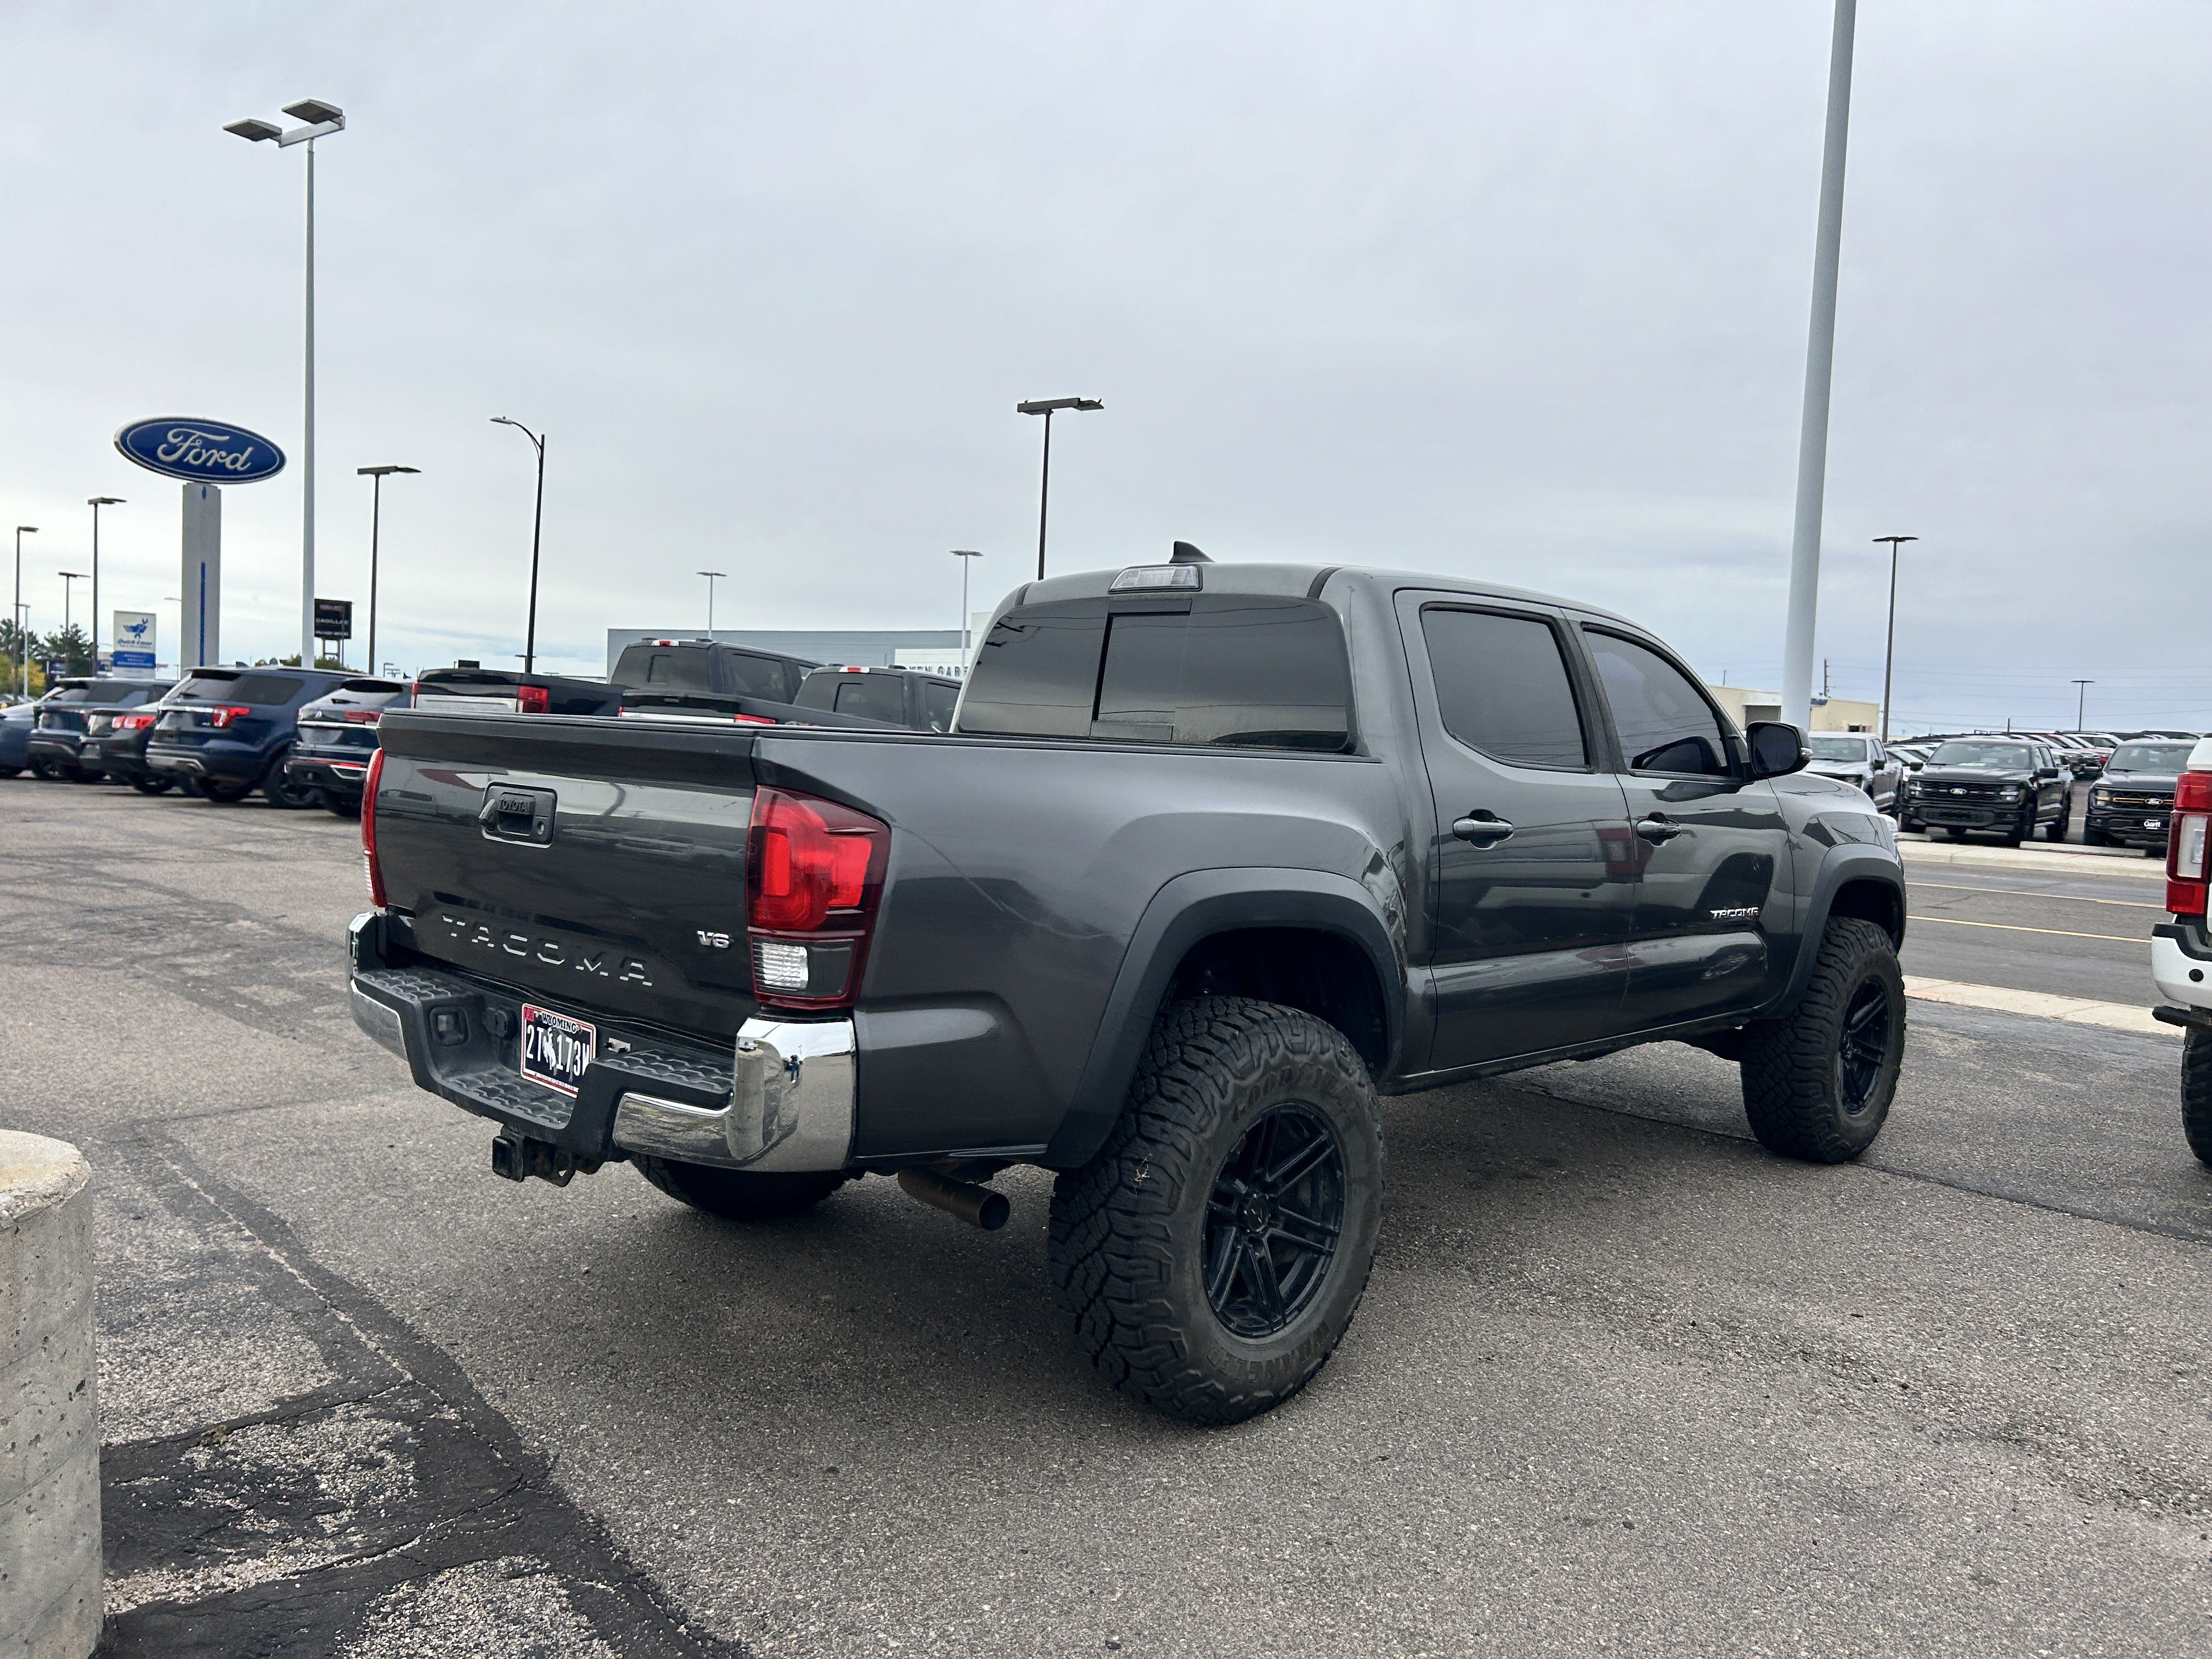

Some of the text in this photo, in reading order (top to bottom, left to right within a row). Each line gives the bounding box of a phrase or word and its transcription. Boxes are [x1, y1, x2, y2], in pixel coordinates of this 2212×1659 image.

[157, 428, 253, 470] Ford
[499, 798, 530, 812] TOYOTA
[1710, 907, 1759, 919] TACOMA
[697, 930, 730, 948] V6
[442, 915, 652, 986] TACOMA
[541, 1013, 576, 1033] WYOMING
